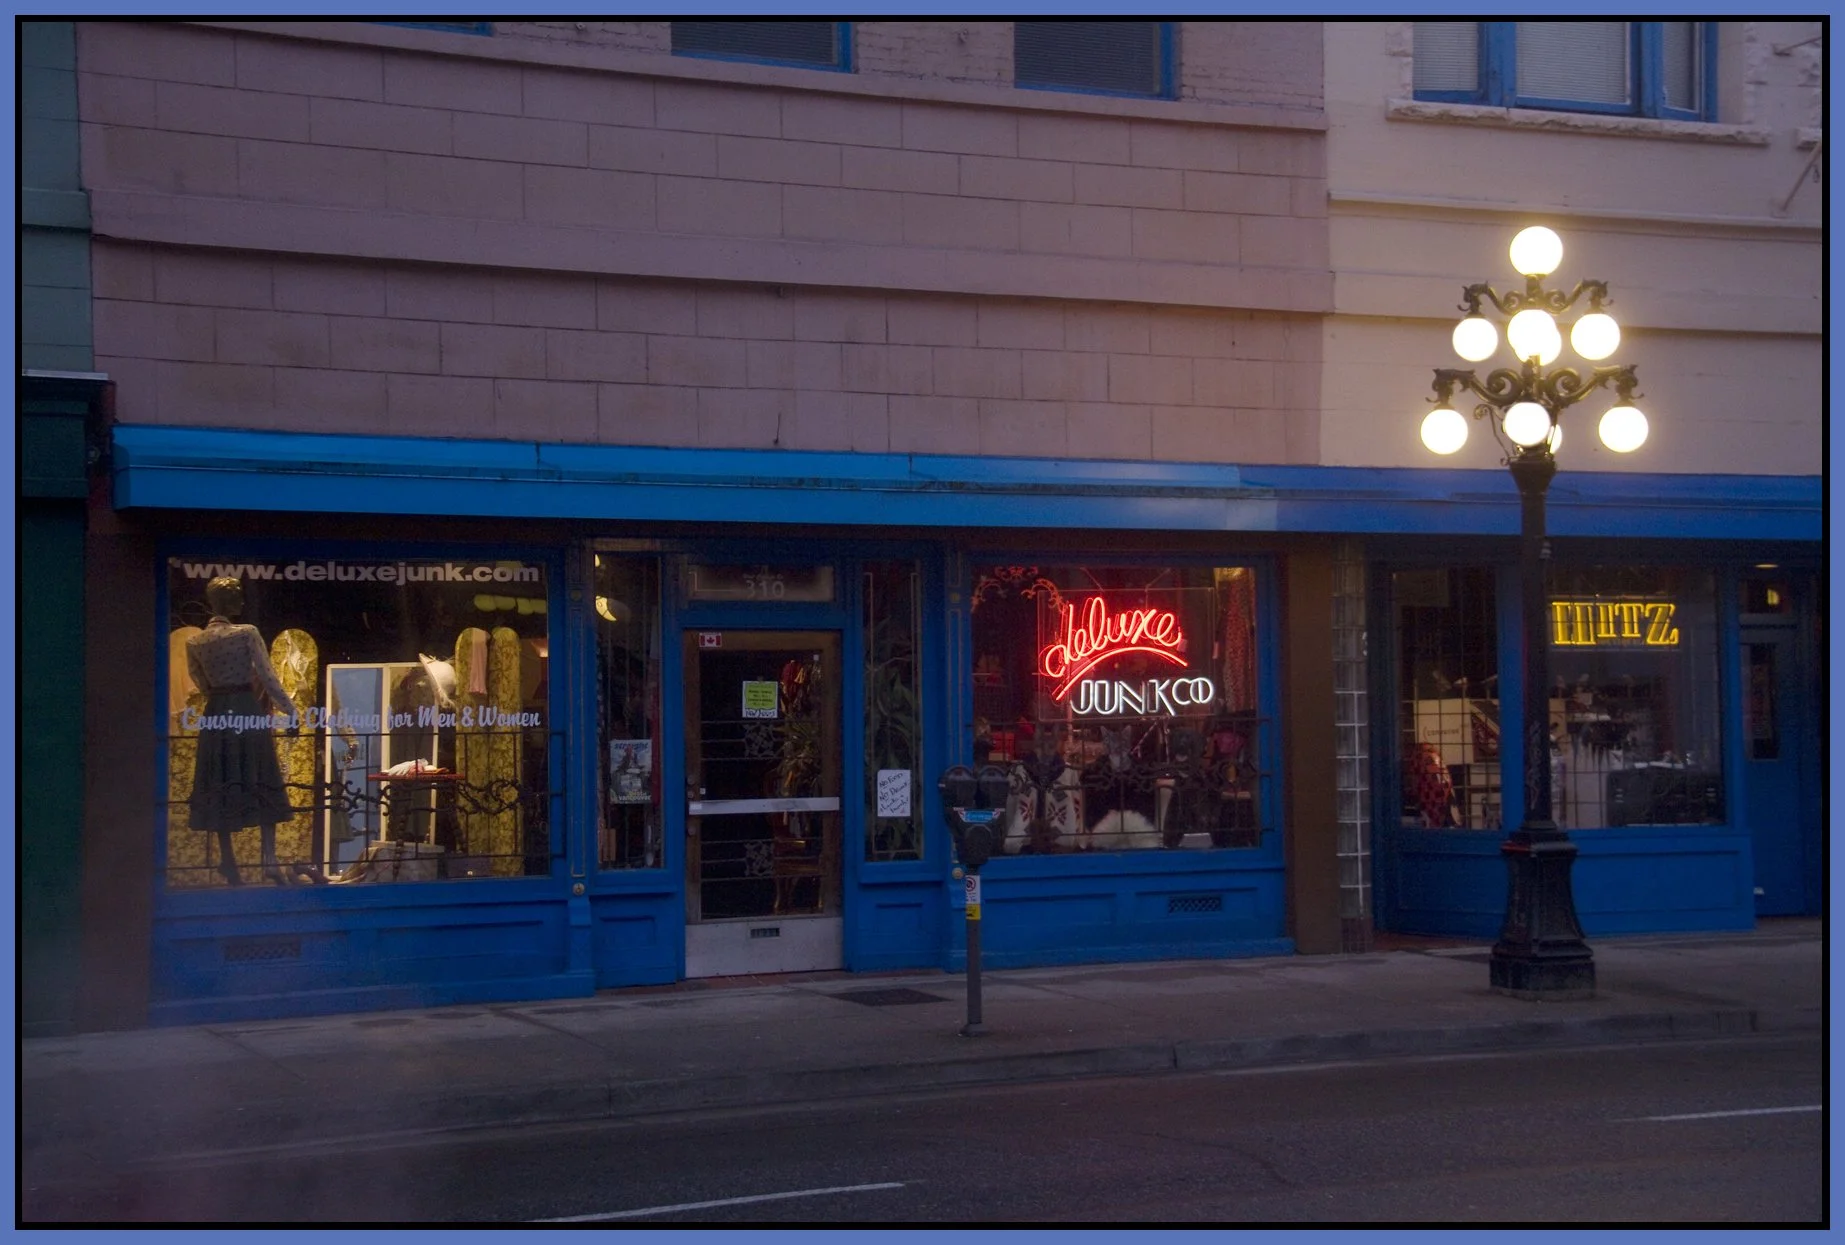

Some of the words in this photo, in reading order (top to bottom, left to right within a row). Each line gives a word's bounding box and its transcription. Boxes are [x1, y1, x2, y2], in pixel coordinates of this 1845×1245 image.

[183, 561, 539, 585] www.deluxejunk.com
[1045, 597, 1182, 678] deluxe
[181, 706, 299, 734] Consignment
[306, 706, 380, 733] Clothing
[387, 704, 413, 731] for
[418, 705, 456, 728] Men
[461, 705, 474, 728] &
[478, 705, 541, 728] Women
